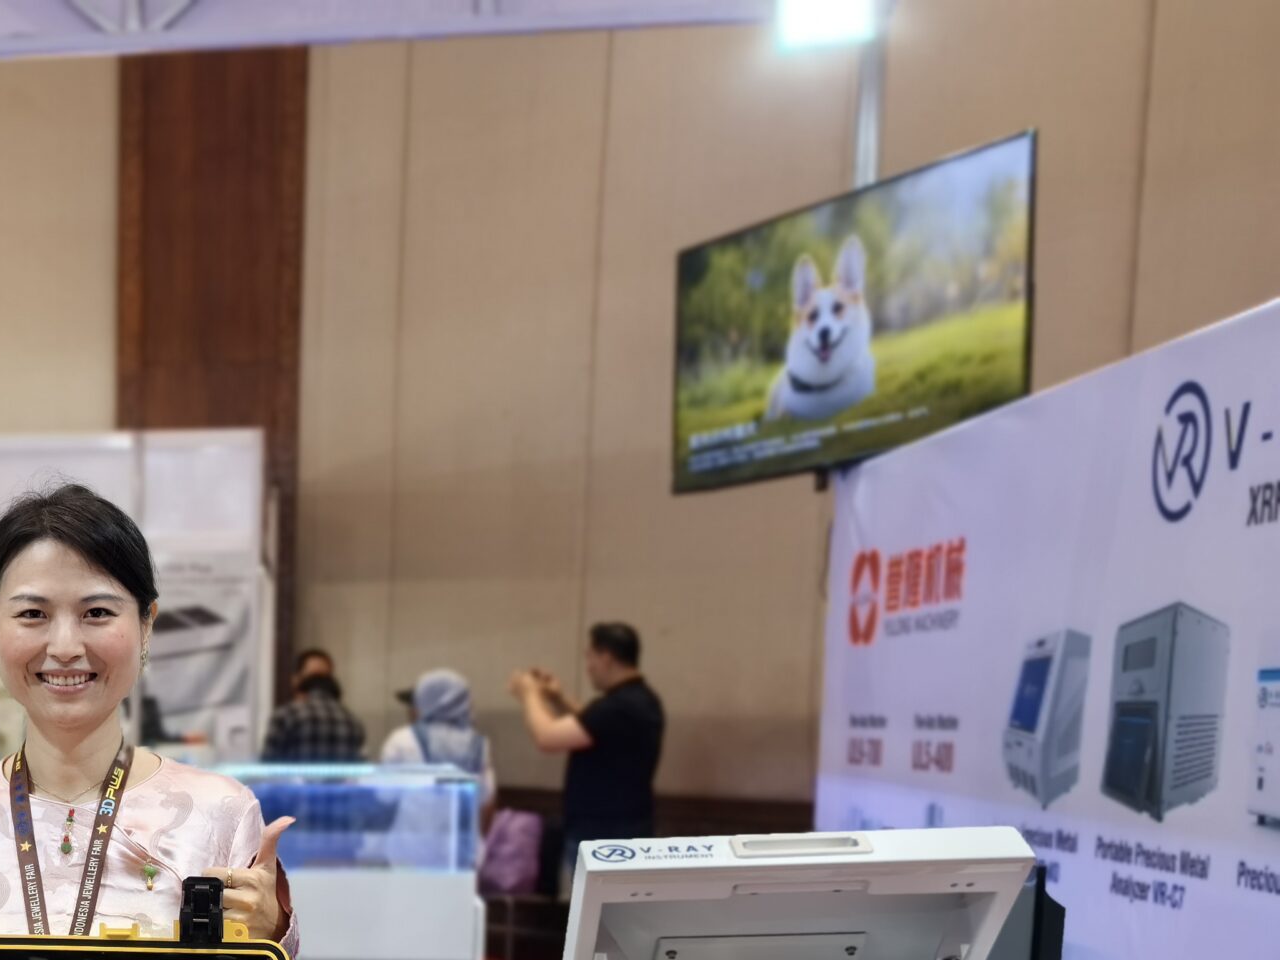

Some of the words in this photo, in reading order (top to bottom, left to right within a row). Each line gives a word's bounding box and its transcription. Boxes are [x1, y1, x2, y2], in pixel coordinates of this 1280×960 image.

[93, 839, 104, 857] FAIR
[1095, 834, 1133, 865] Portable
[1134, 842, 1177, 875] Precious
[1179, 848, 1211, 881] Metal
[24, 863, 35, 881] FAIR
[82, 856, 101, 901] JEWELLERY
[1110, 871, 1151, 903] Analyzer
[26, 881, 42, 921] JEWELLERY
